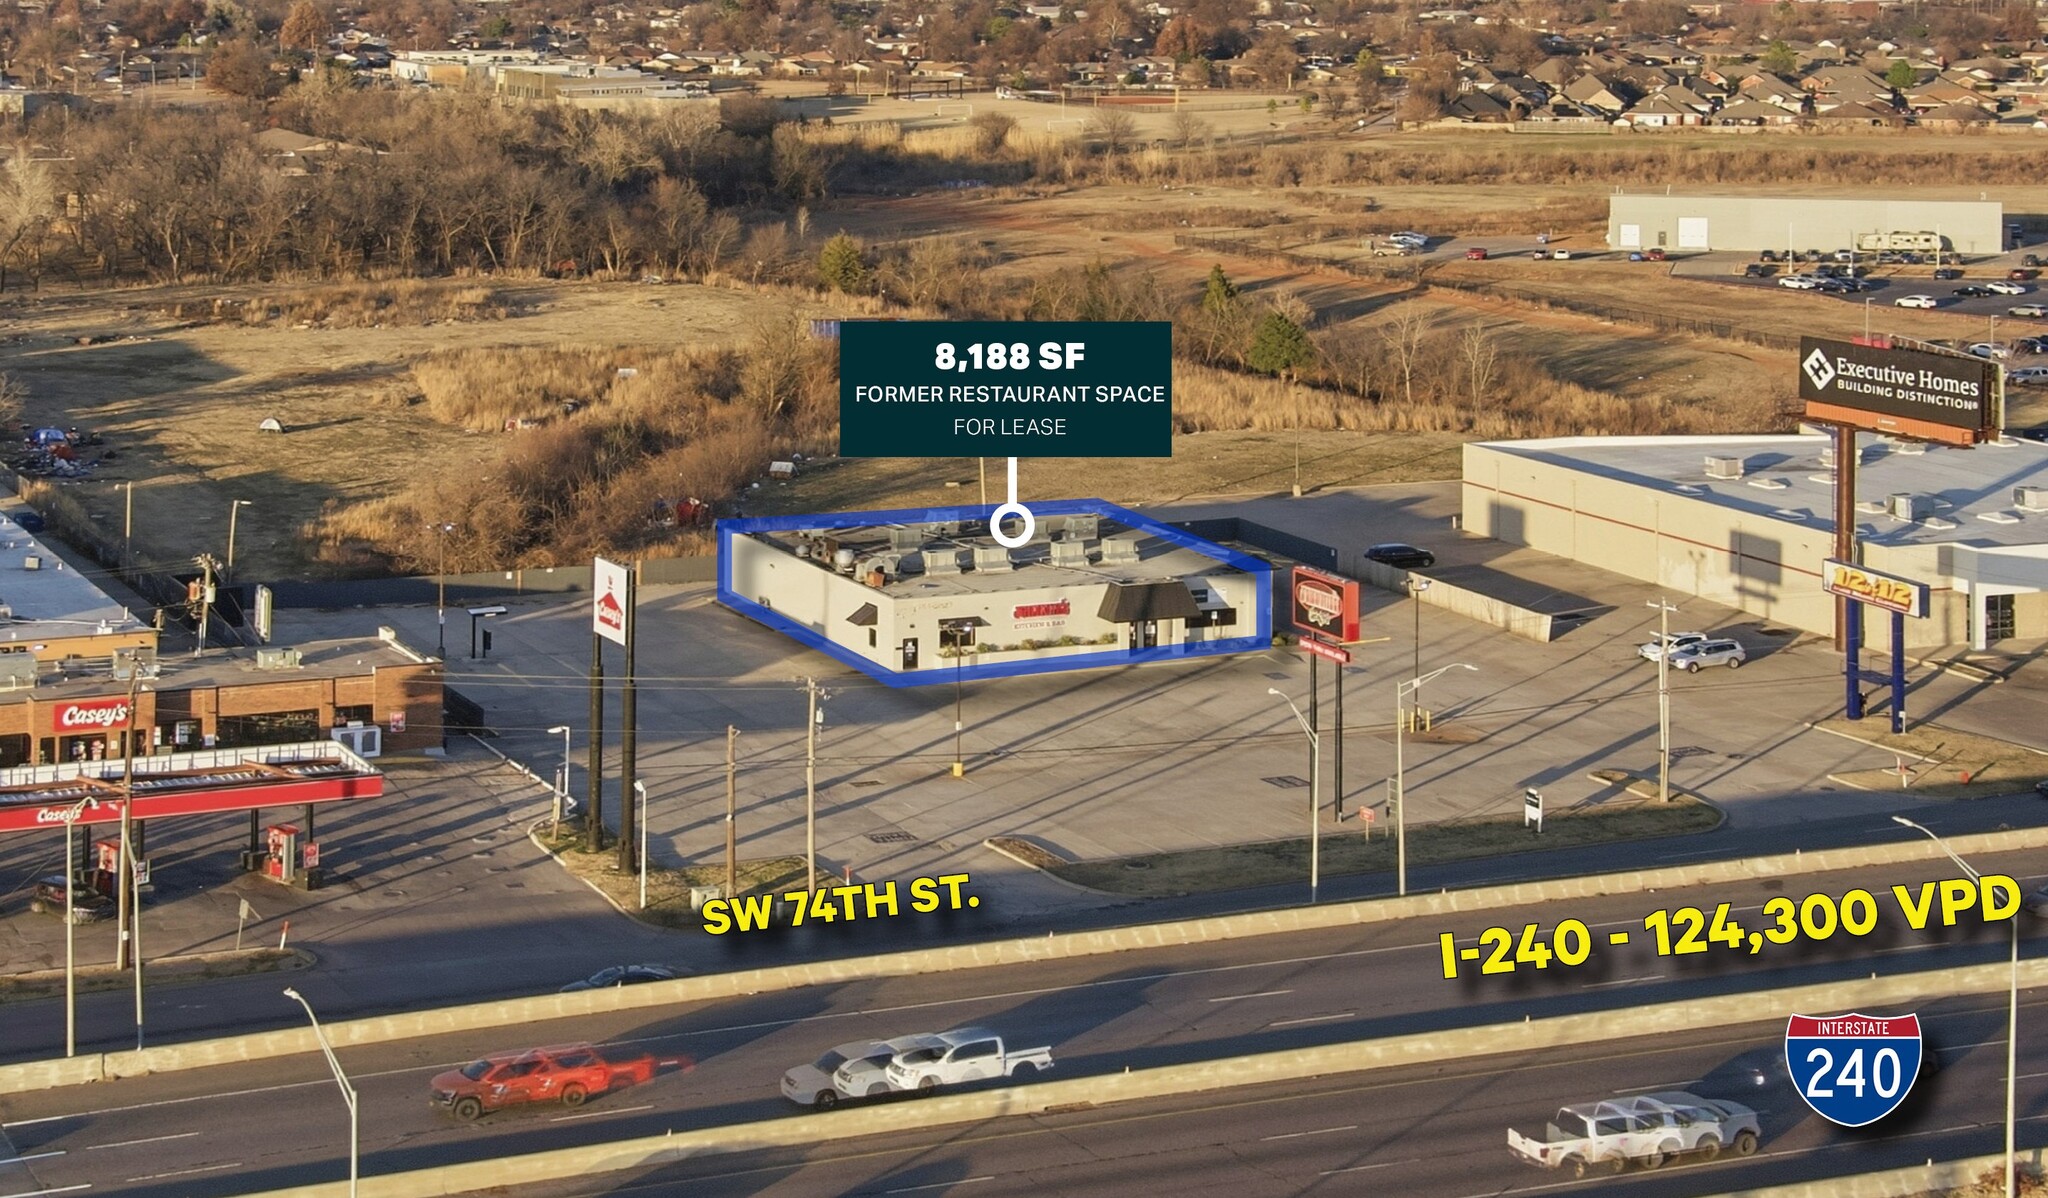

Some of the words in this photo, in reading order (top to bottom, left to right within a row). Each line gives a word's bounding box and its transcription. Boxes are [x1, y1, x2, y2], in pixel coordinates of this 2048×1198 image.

[1836, 357, 1916, 387] Executive
[1918, 369, 1979, 397] Homes
[1837, 379, 1893, 398] BUILDING
[599, 600, 621, 625] Casey's
[62, 703, 127, 726] Casey's
